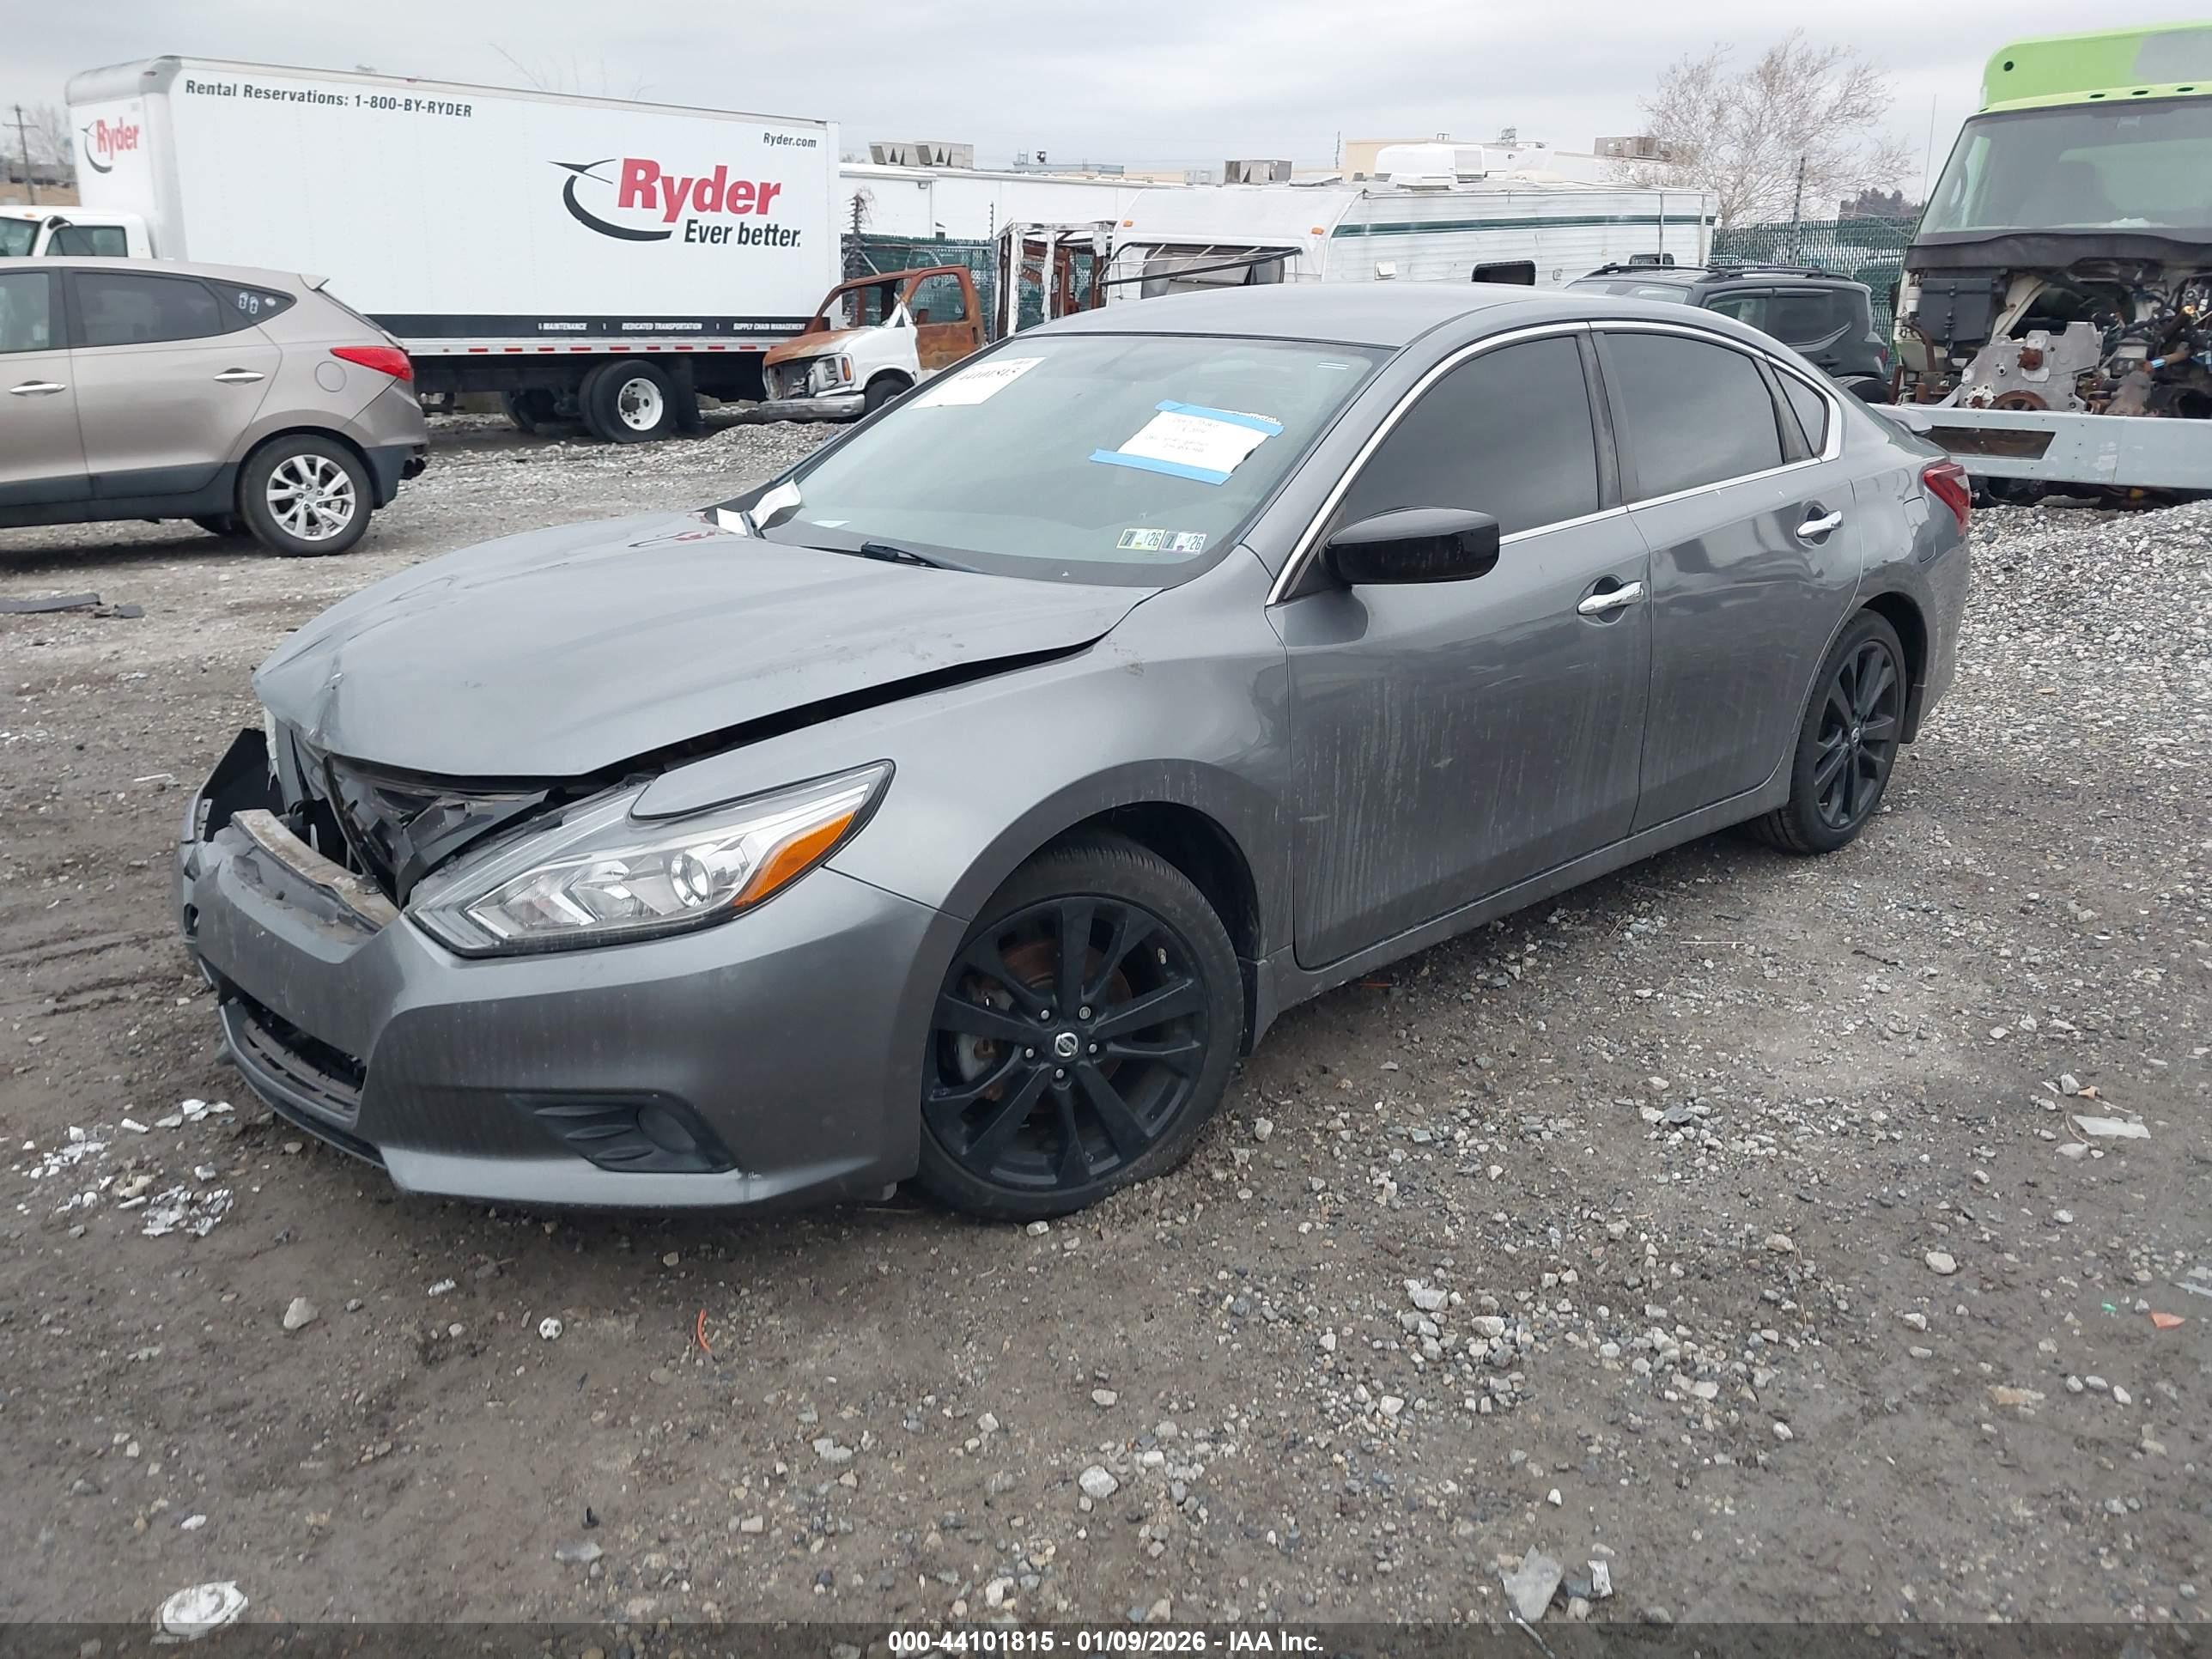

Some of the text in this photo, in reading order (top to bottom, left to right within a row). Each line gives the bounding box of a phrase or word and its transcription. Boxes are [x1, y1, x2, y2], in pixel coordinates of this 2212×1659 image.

[185, 80, 472, 118] Rental Reservations: 1-800-BY-RYDER
[96, 117, 140, 161] Ryder
[763, 132, 817, 149] Ryder.com
[617, 158, 781, 223] Ryder
[684, 219, 801, 248] Ever better.
[732, 322, 753, 331] SUPPLY
